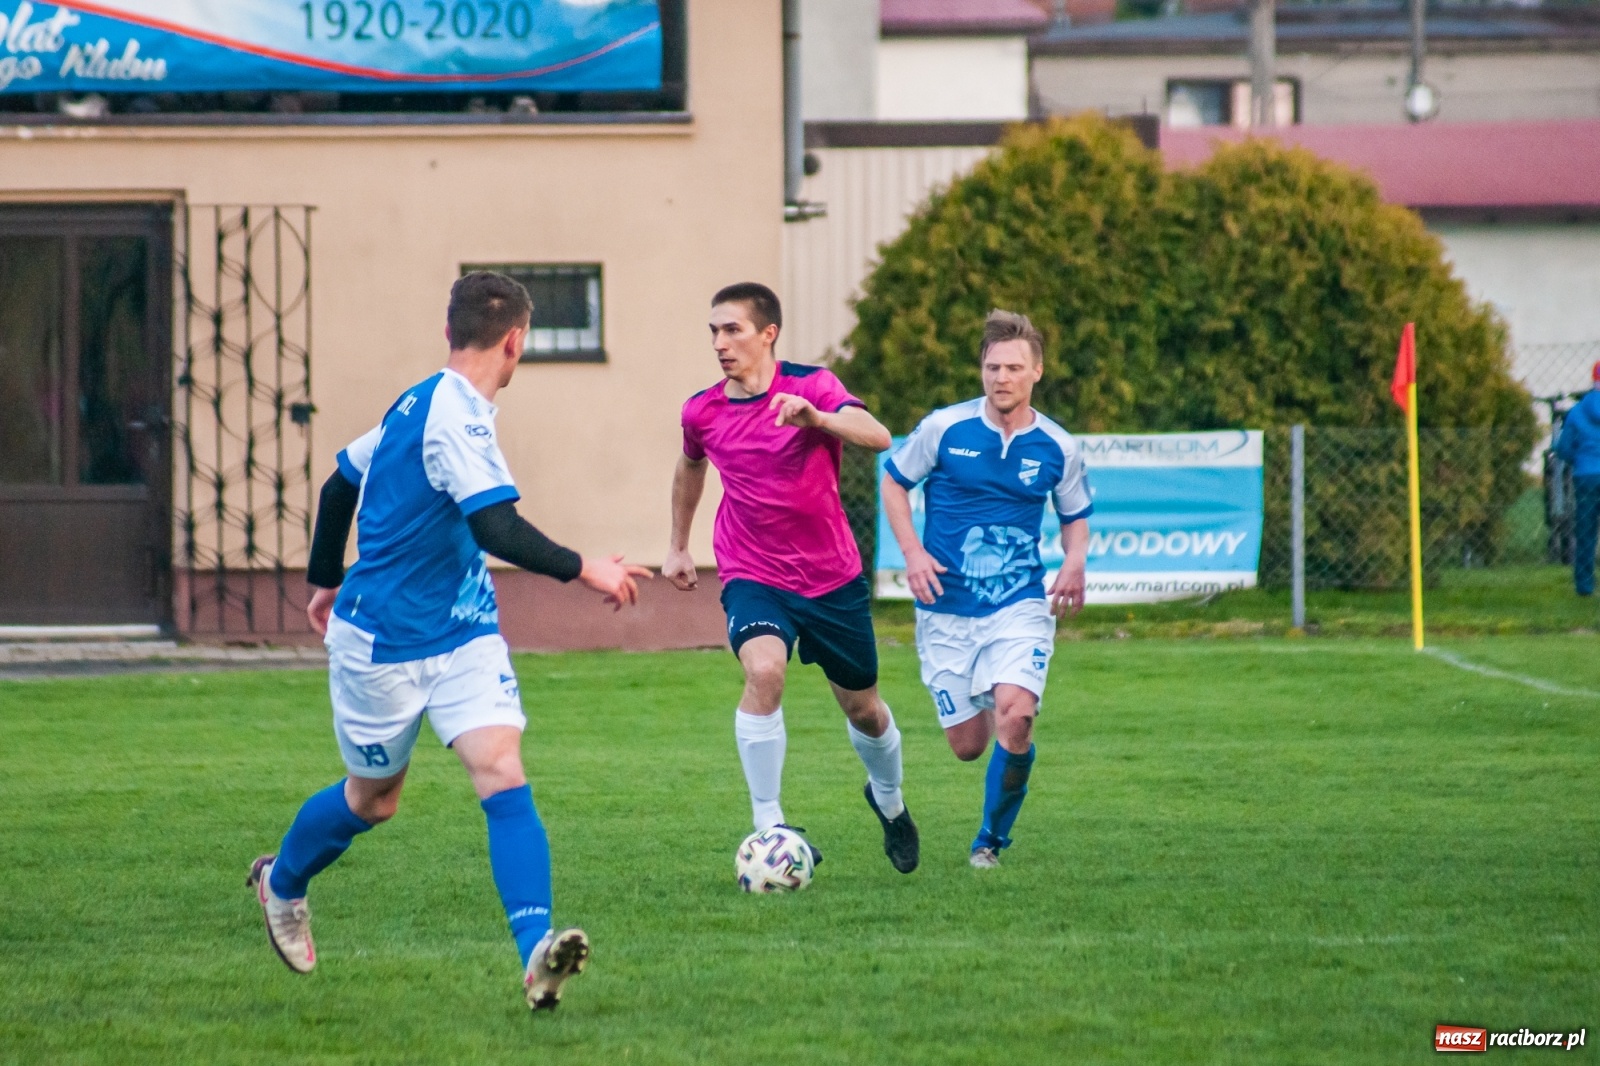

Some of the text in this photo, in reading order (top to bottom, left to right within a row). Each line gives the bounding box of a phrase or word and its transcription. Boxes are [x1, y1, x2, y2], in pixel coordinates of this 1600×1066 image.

[299, 1, 533, 40] 1920-2020
[59, 37, 167, 81] Klubu
[1080, 438, 1219, 454] MARTCOM
